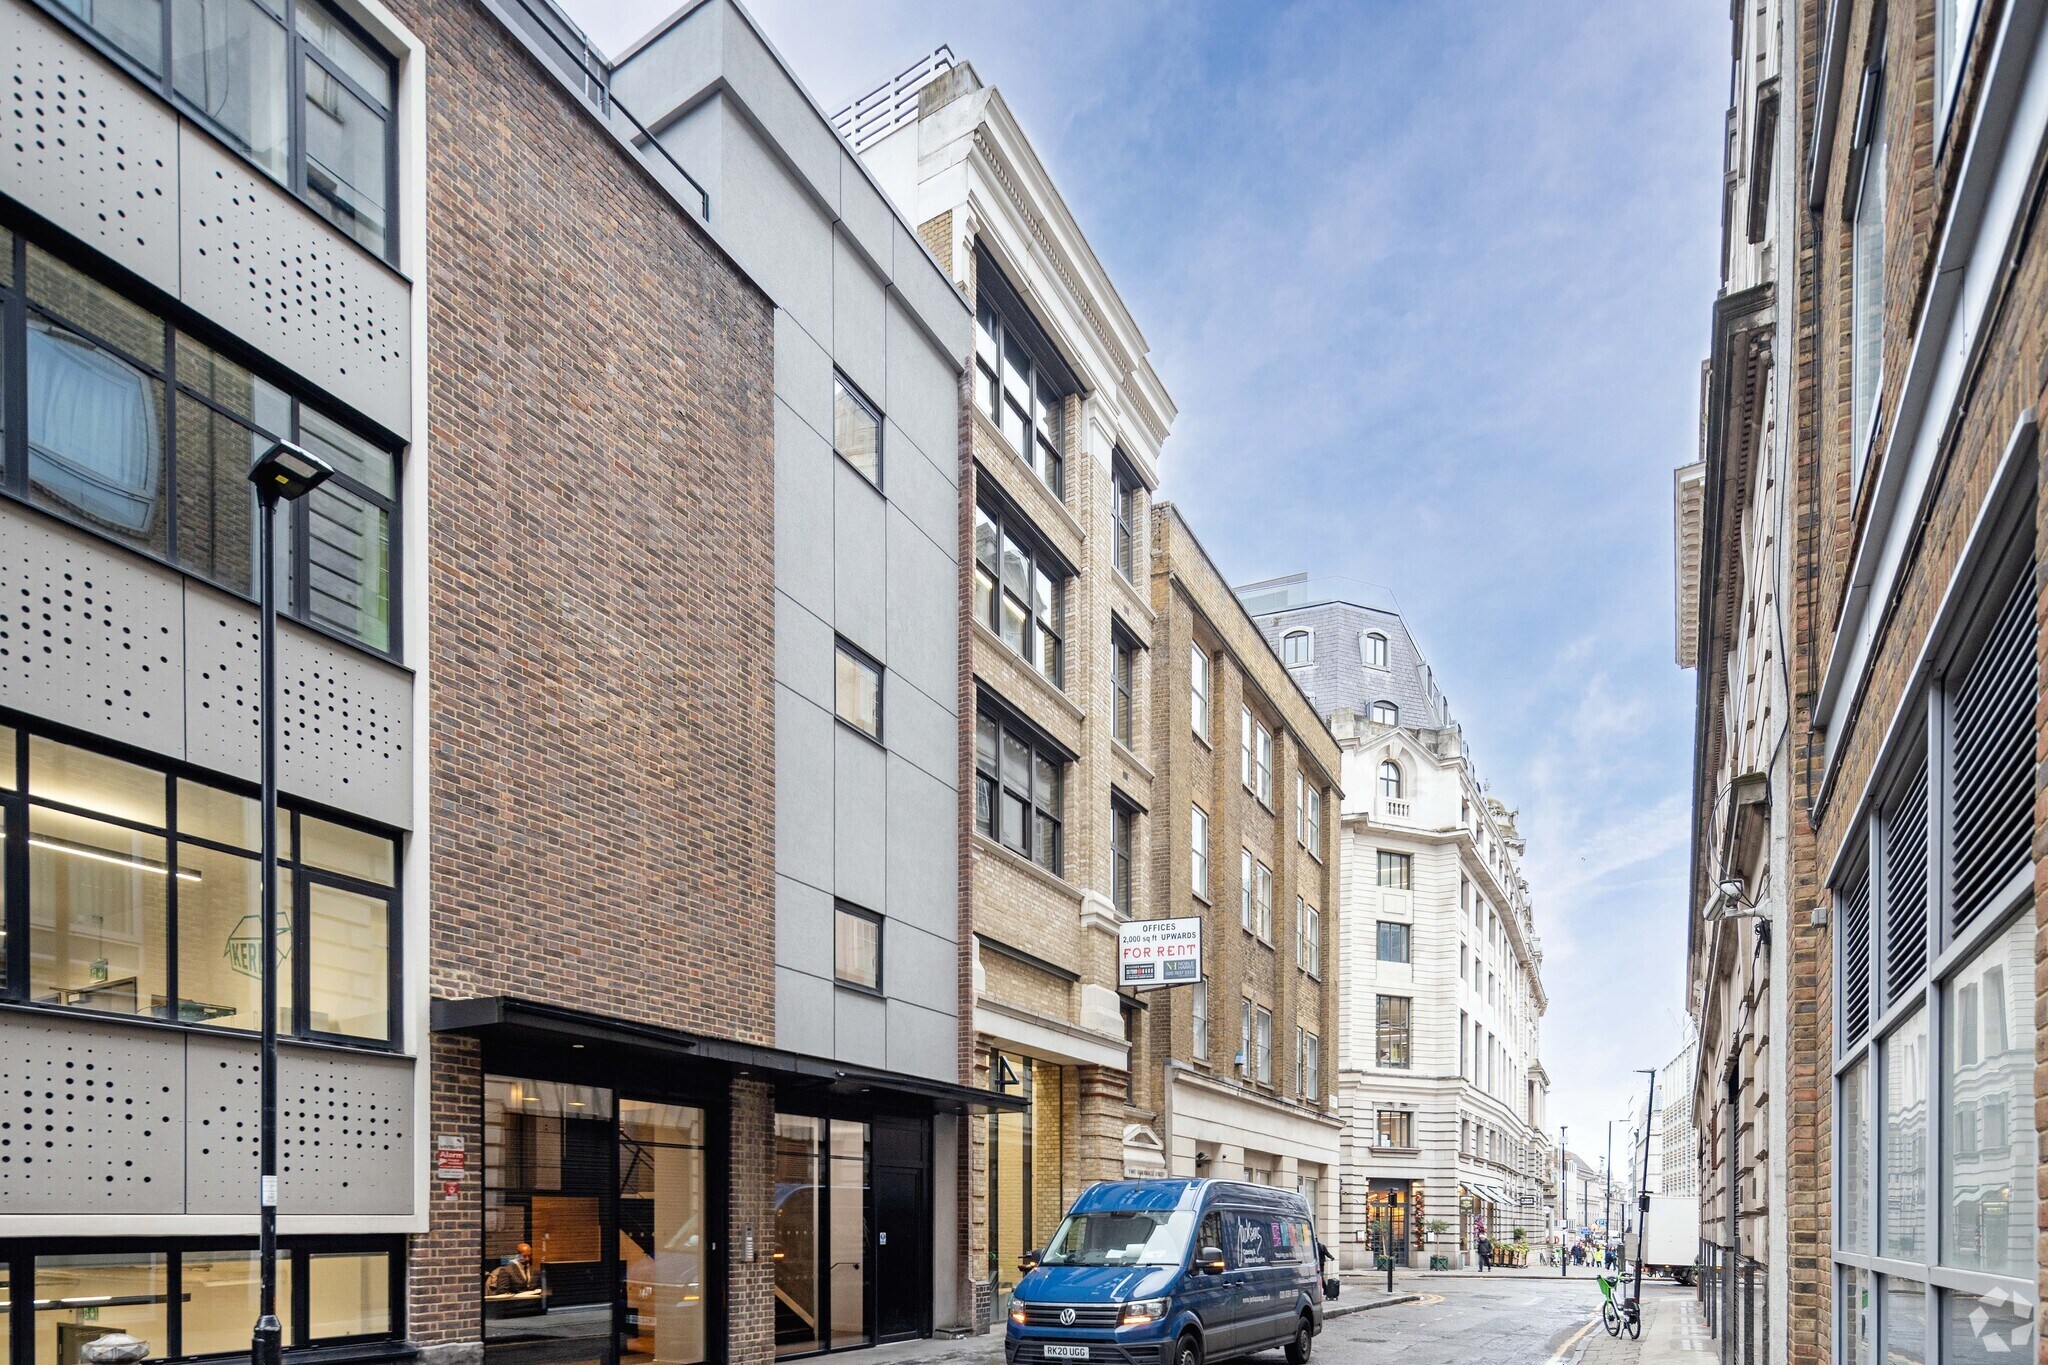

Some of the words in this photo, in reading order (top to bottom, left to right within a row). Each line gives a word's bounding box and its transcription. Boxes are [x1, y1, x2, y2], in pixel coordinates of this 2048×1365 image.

[1142, 923, 1176, 932] OFFICES
[1123, 935, 1141, 944] 2,000
[1161, 931, 1197, 940] UPWARDS
[1123, 947, 1151, 959] FOR
[1157, 944, 1196, 957] RENT
[232, 942, 262, 975] KER
[1047, 1346, 1068, 1356] RK20
[1069, 1347, 1086, 1357] UGG
